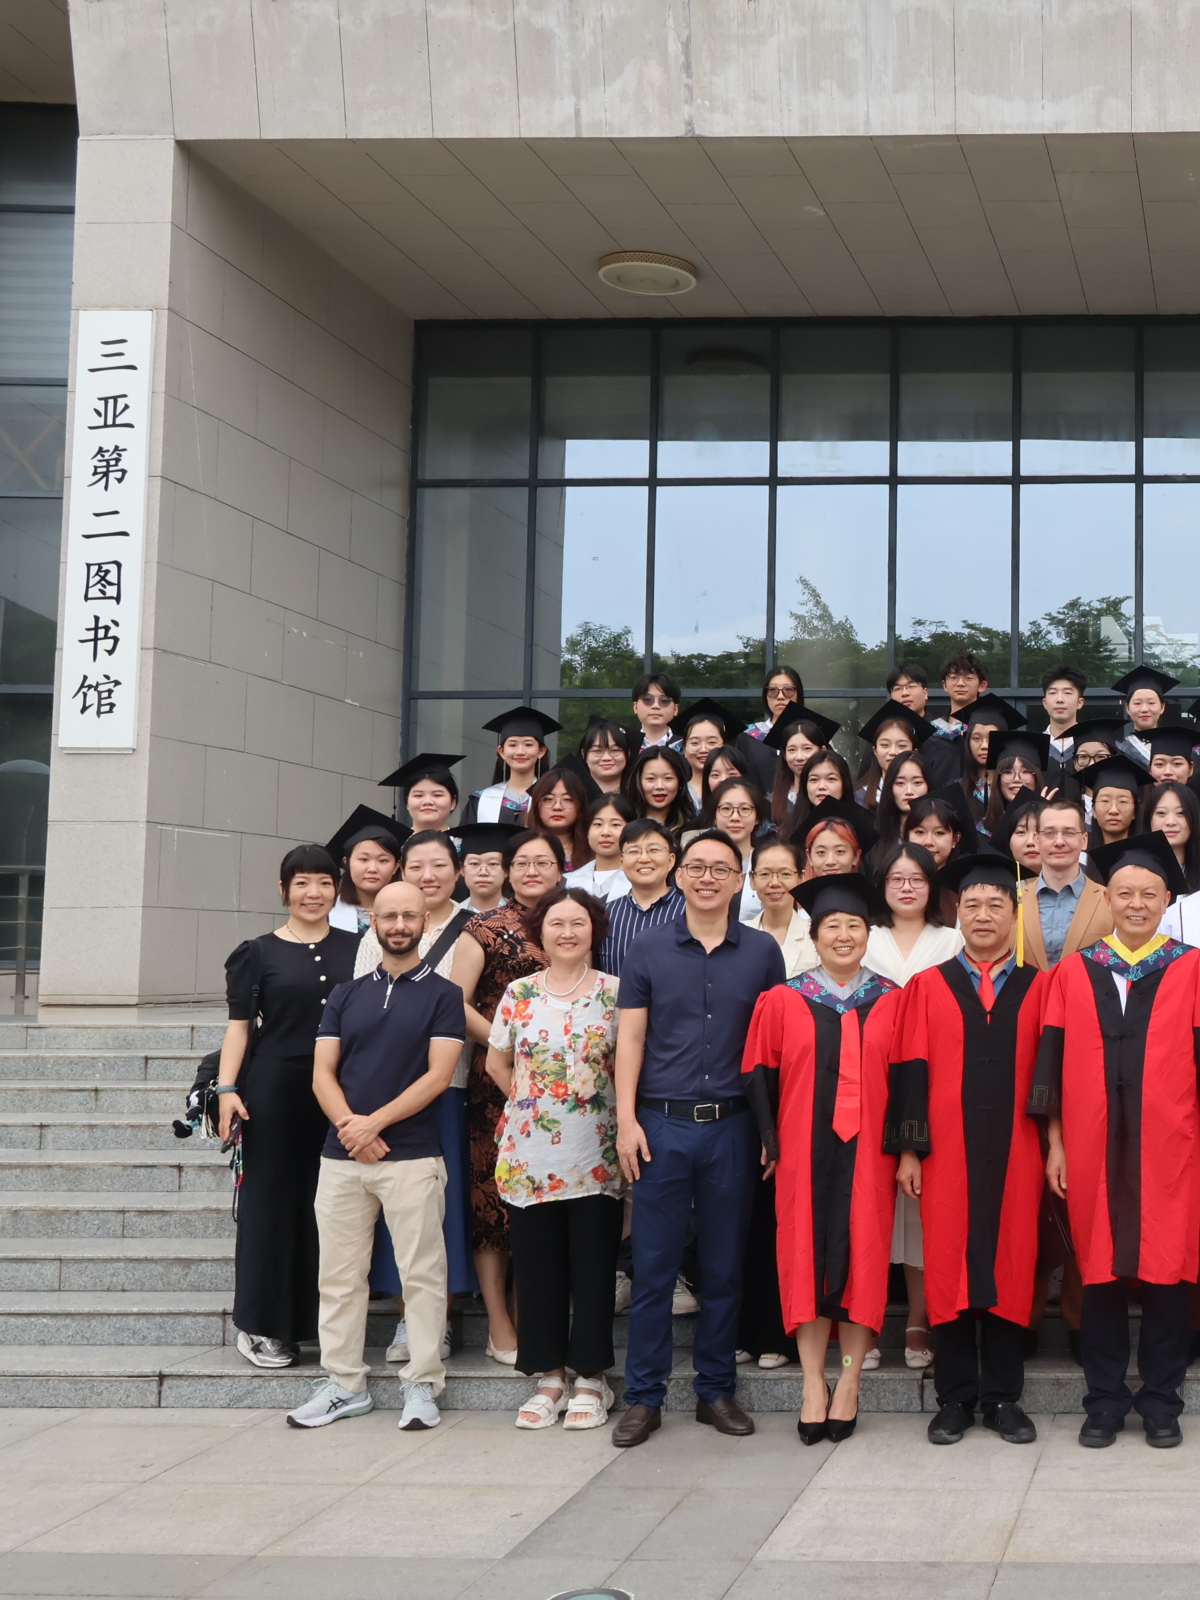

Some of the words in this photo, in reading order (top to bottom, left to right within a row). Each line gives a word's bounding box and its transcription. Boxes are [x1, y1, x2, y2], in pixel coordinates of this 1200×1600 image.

[72, 338, 139, 719] 三亚第二图书馆
